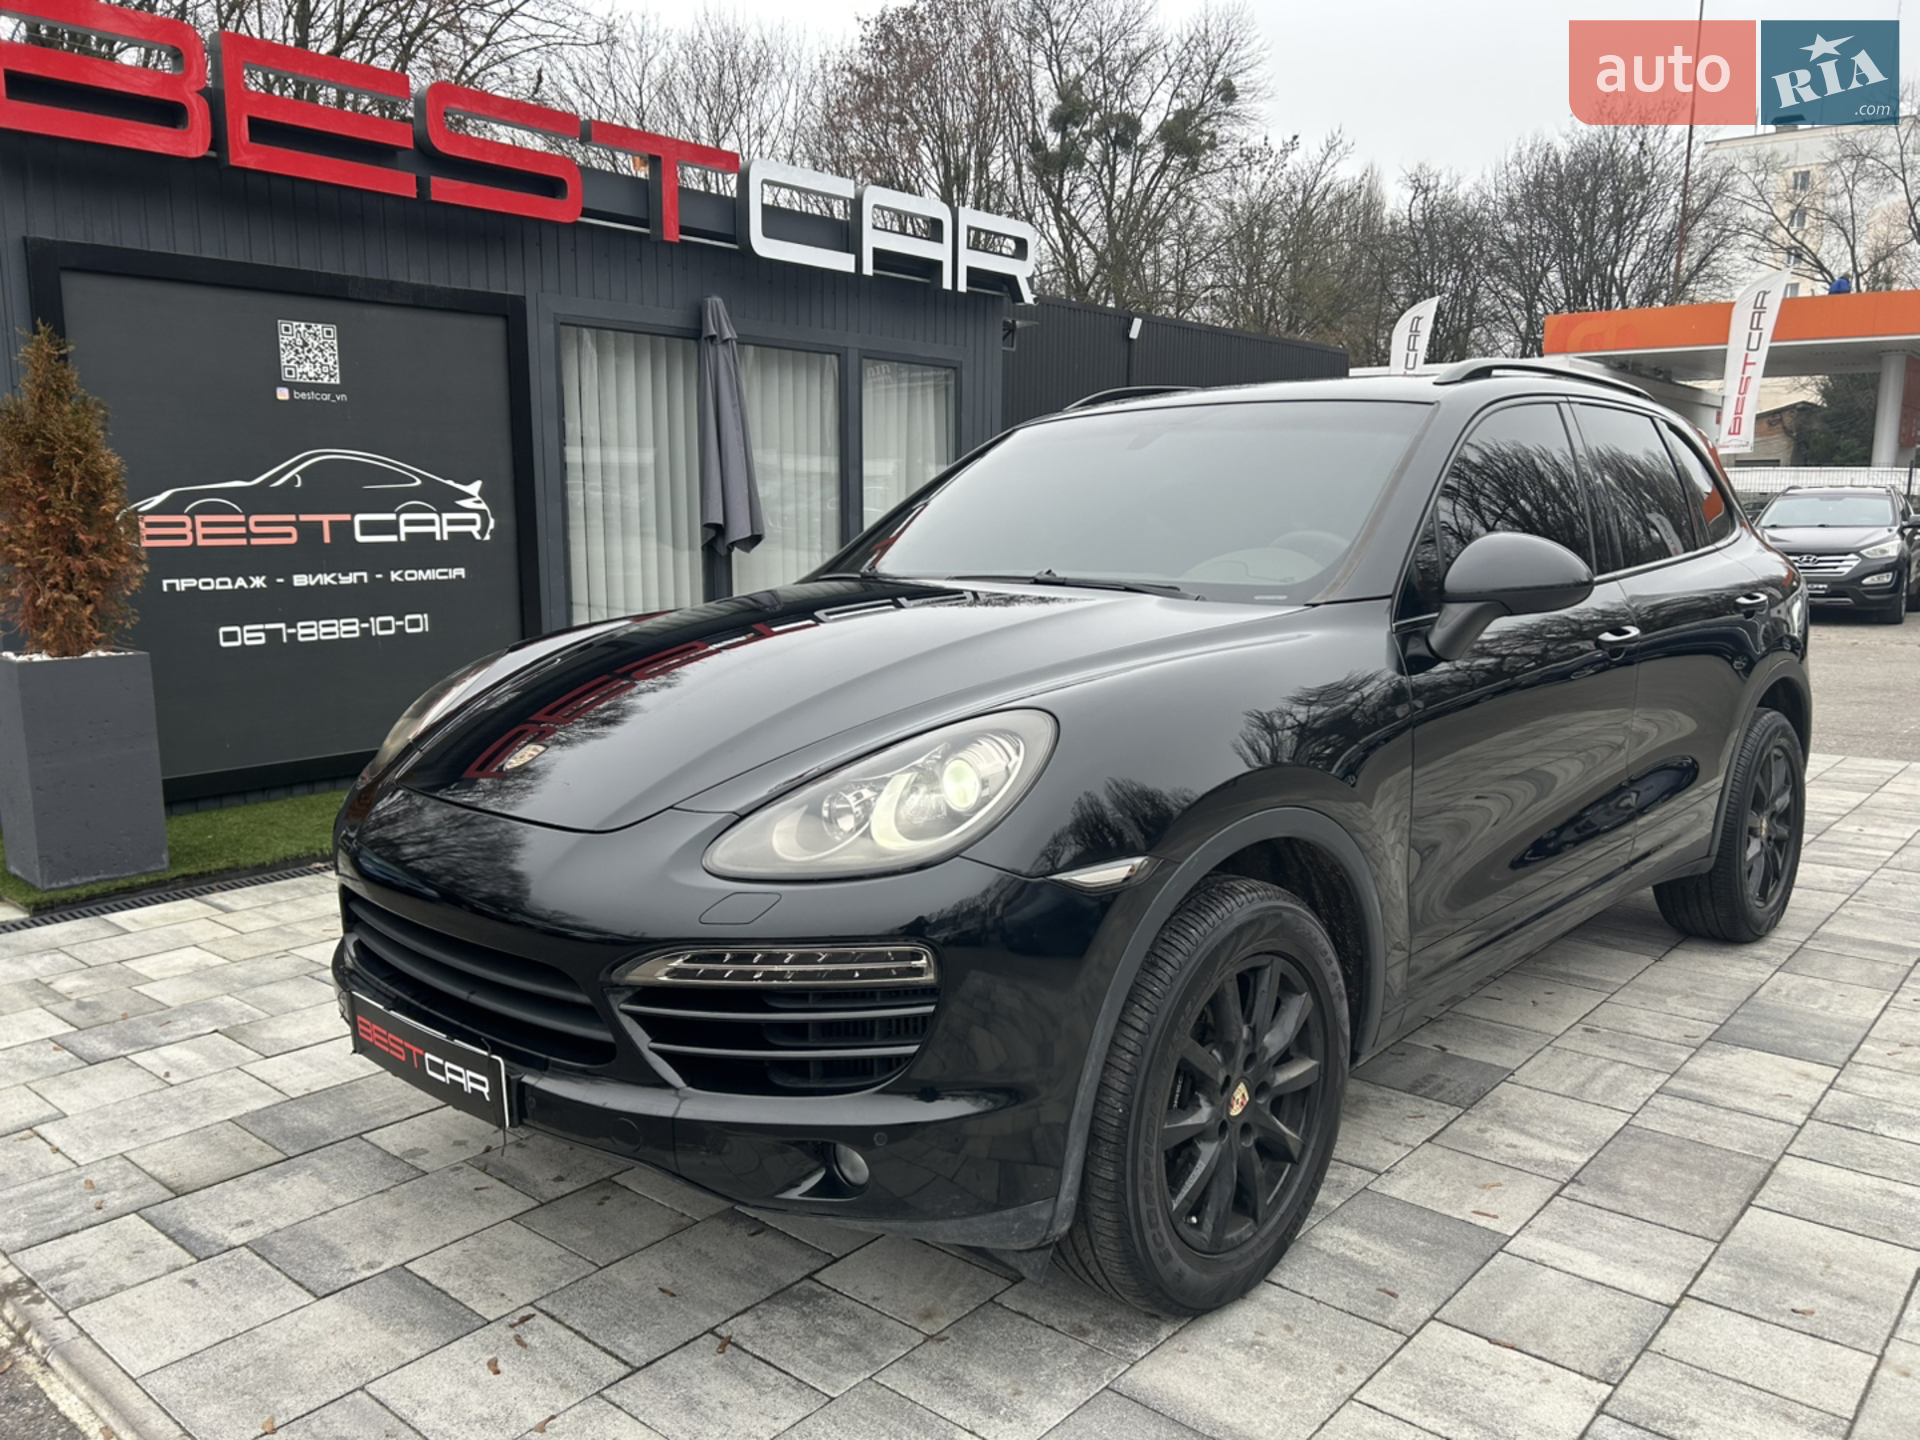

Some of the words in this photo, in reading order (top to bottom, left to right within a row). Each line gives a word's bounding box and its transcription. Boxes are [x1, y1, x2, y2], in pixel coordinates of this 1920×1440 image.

[292, 389, 348, 403] bestcar_vn
[162, 575, 268, 592] ПРОДАЖ
[292, 571, 368, 587] ВИКУП
[389, 567, 466, 582] КОМІСІЯ
[218, 612, 430, 647] 067-888-10-01
[356, 1015, 491, 1102] BESTCAR
